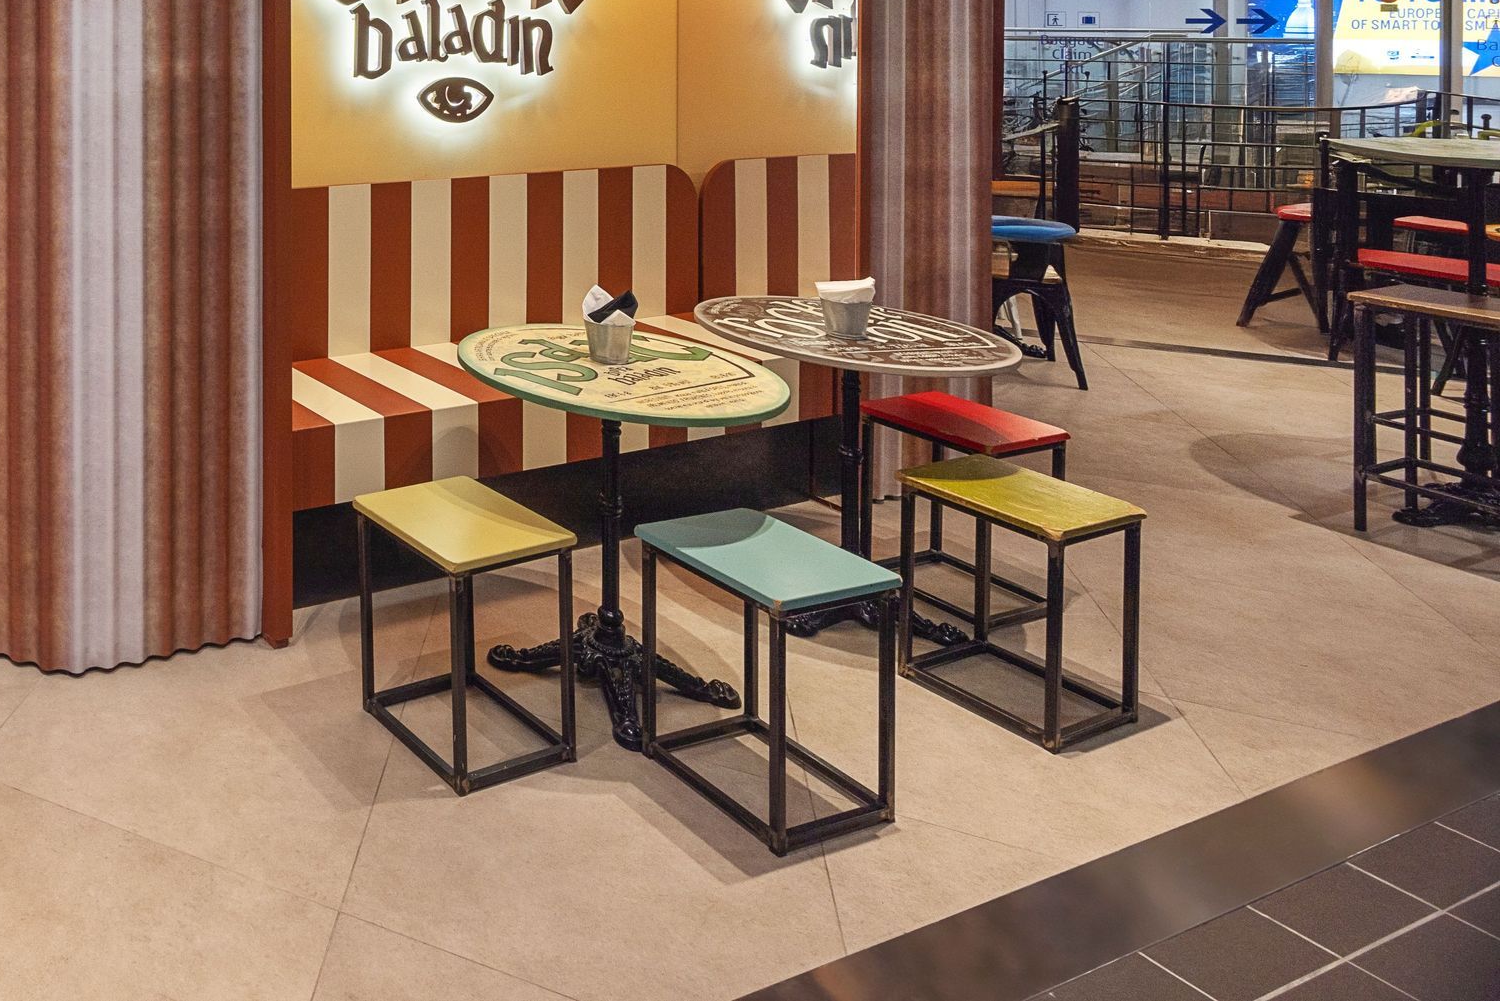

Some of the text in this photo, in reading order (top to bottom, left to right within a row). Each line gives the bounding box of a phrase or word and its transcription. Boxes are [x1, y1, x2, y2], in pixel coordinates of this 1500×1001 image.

[1389, 8, 1442, 19] EUROPE
[1351, 20, 1367, 30] OF
[1371, 20, 1418, 31] SMART
[1052, 48, 1092, 60] Claim
